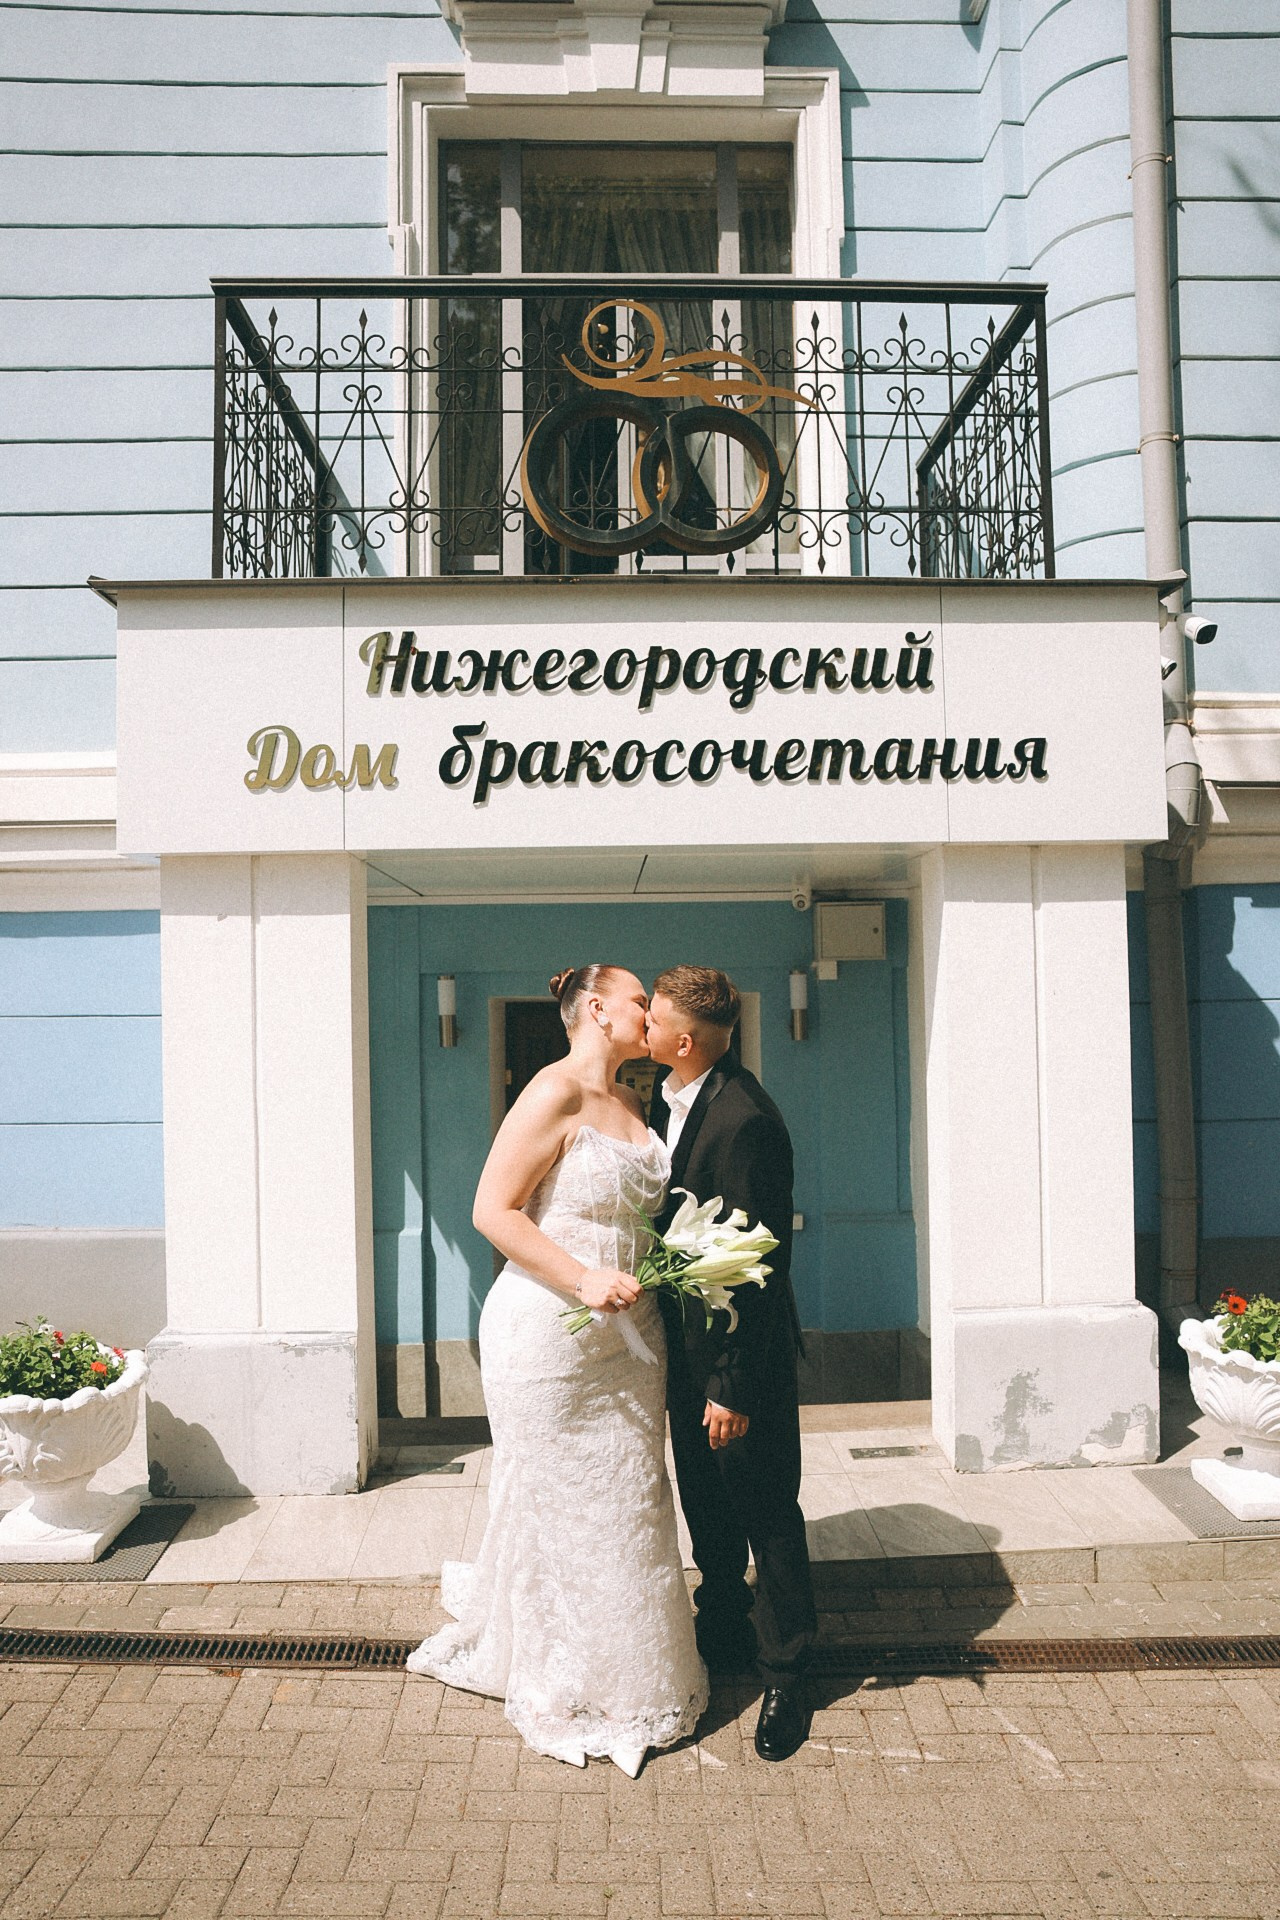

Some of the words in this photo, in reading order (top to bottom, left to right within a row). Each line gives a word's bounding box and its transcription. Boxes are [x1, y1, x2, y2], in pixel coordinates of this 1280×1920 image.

[358, 630, 934, 711] Нижегородский
[243, 724, 400, 790] Дом
[438, 720, 1049, 807] бракосочетания
